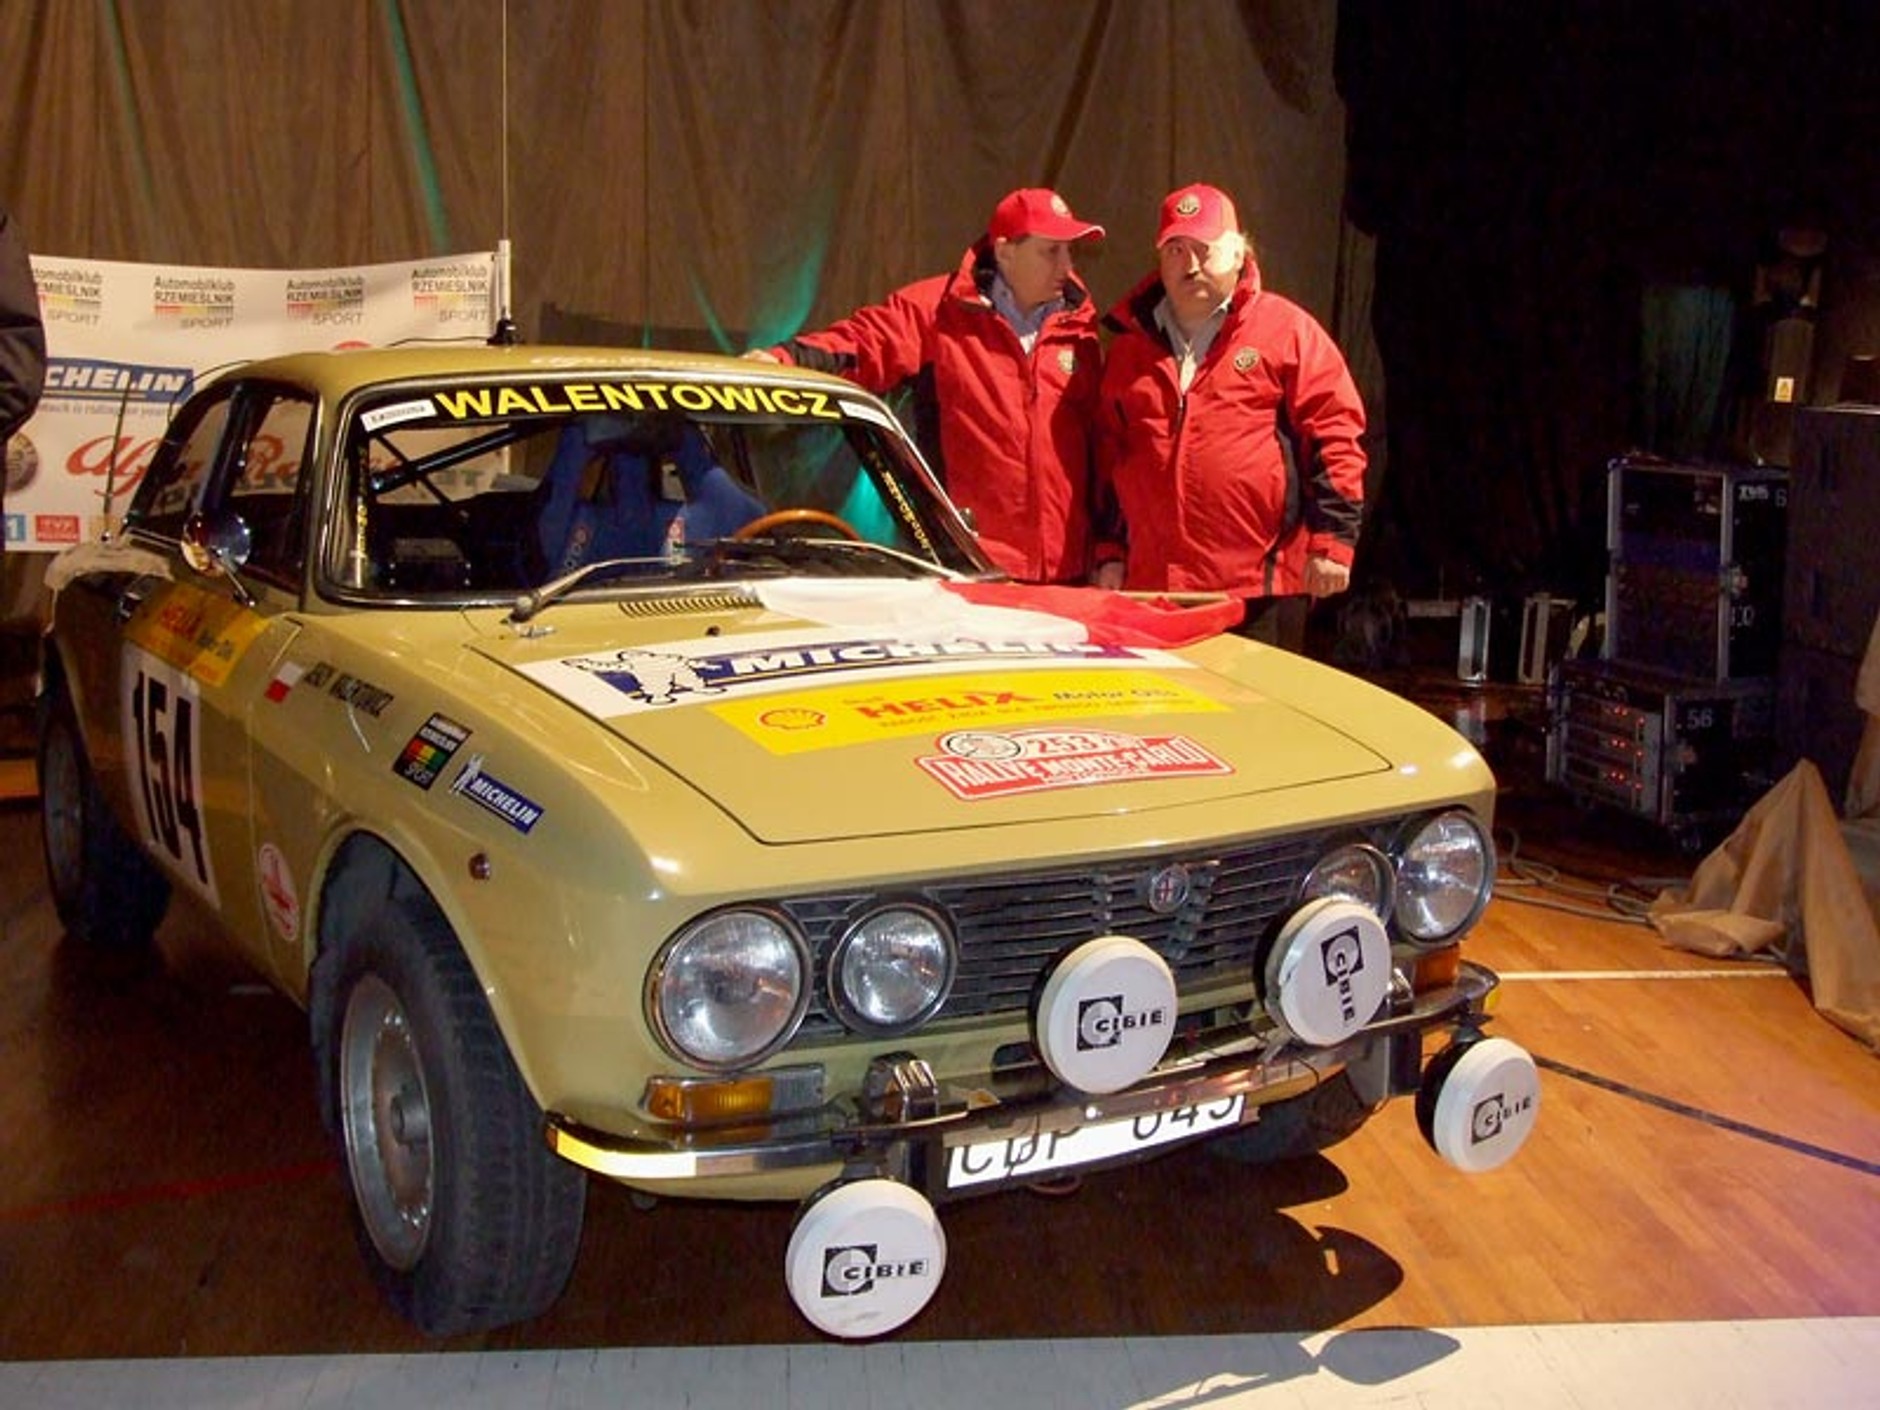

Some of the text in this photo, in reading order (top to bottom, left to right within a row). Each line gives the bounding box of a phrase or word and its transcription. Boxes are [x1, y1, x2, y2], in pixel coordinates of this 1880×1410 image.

[49, 310, 100, 325] SPORT
[180, 316, 233, 329] SPORT
[313, 312, 363, 326] SPORT
[438, 309, 488, 323] SPORT
[46, 366, 186, 391] CHELIN
[434, 384, 842, 420] WALENTOWICZ
[856, 690, 1038, 718] HELIX
[133, 670, 208, 884] 154
[942, 758, 1042, 788] RALLYE
[470, 777, 539, 824] MICHELIN
[1095, 1010, 1163, 1033] CIBIE
[843, 1261, 924, 1280] CIBIE
